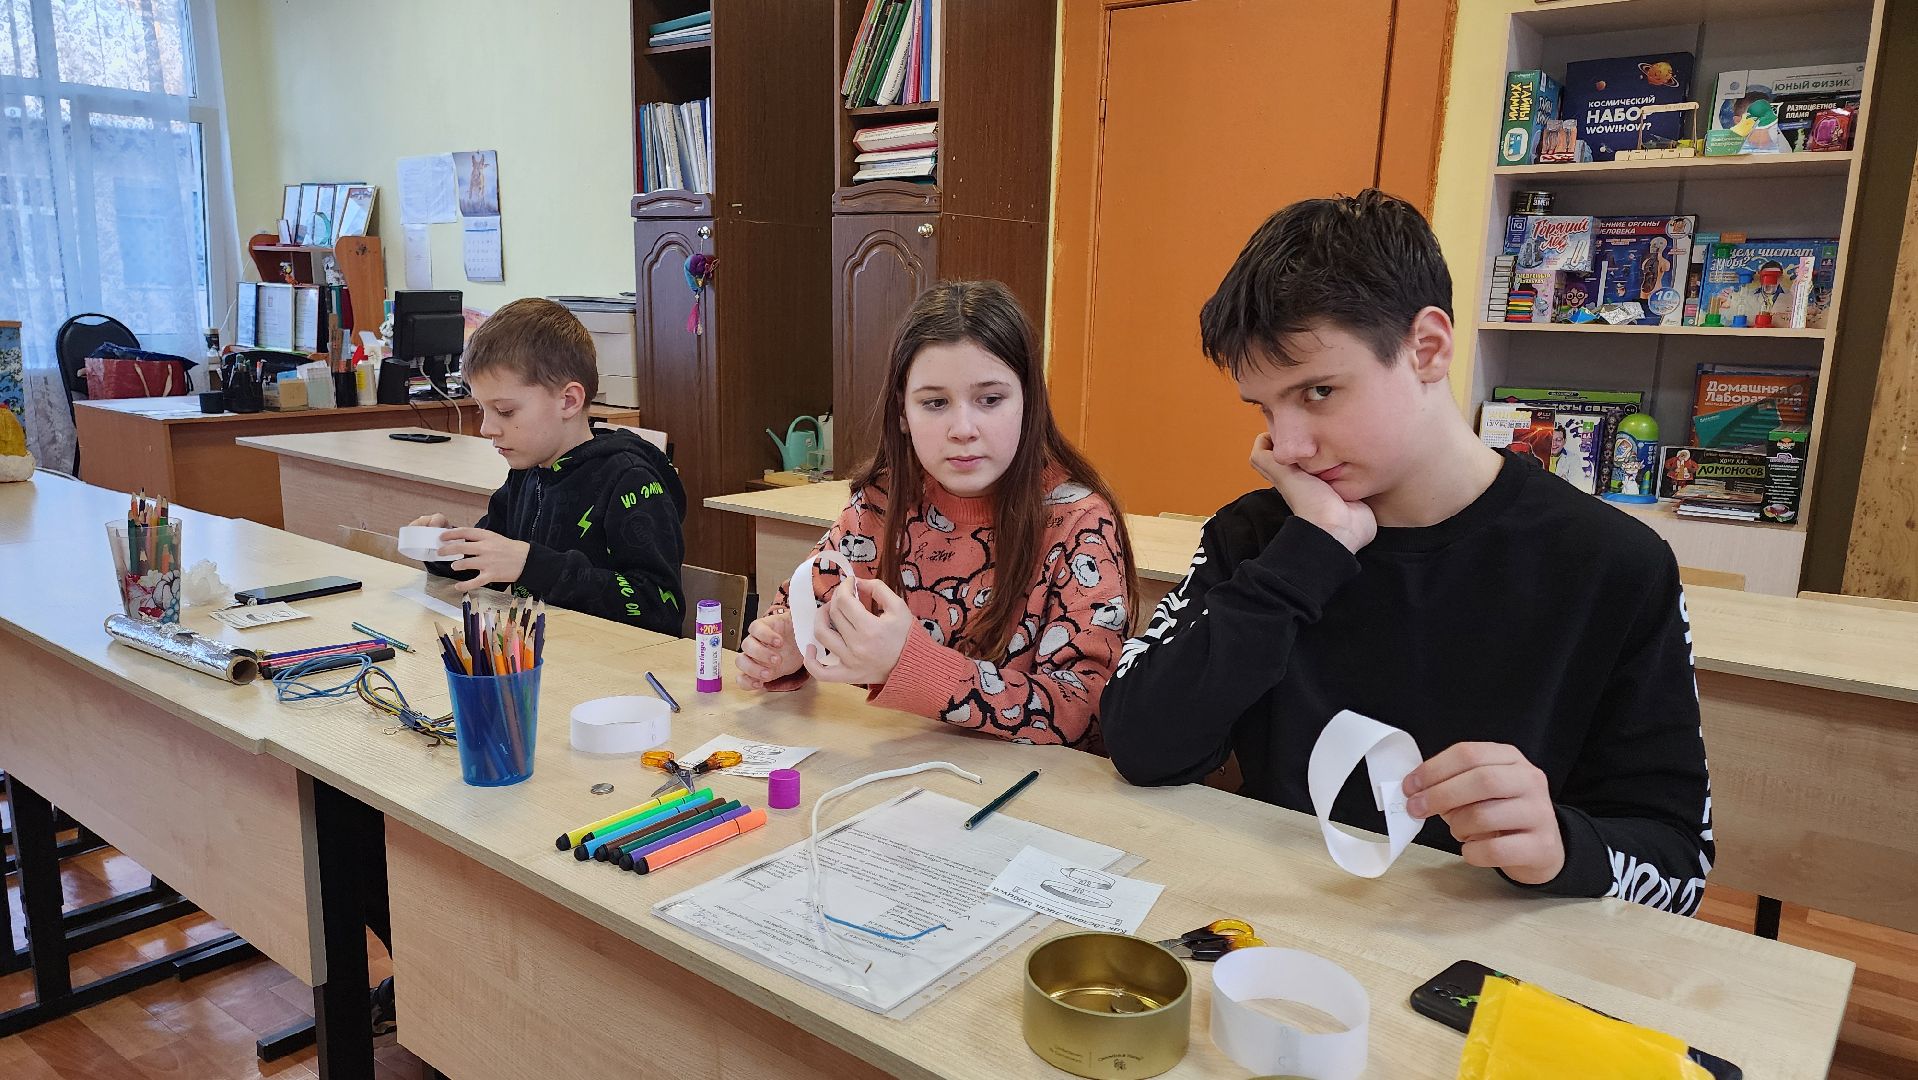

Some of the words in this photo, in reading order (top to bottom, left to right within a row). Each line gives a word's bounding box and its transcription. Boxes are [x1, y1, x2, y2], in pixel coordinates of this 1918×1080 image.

[1774, 80, 1810, 92] ЮНЫЙ
[1812, 79, 1851, 89] ФИЗИК
[1508, 82, 1522, 121] ХИМИИ
[1519, 81, 1533, 121] ТАЙНЫ
[1588, 95, 1656, 108] КОСМИЧЕСКИЙ
[1786, 103, 1837, 112] РАЗНОЦВЕТНОЕ
[1785, 111, 1810, 119] ПЛАМЯ
[1586, 122, 1651, 135] WOW!HOW?
[1513, 222, 1523, 230] IQ
[1533, 217, 1590, 240] Горячий
[1627, 220, 1660, 228] ОРГАНЫ
[1758, 248, 1814, 258] чистят
[1707, 380, 1788, 394] Домашняя
[1705, 392, 1801, 407] Лаборатрия
[1698, 464, 1764, 476] ЛОМОНОСОВ
